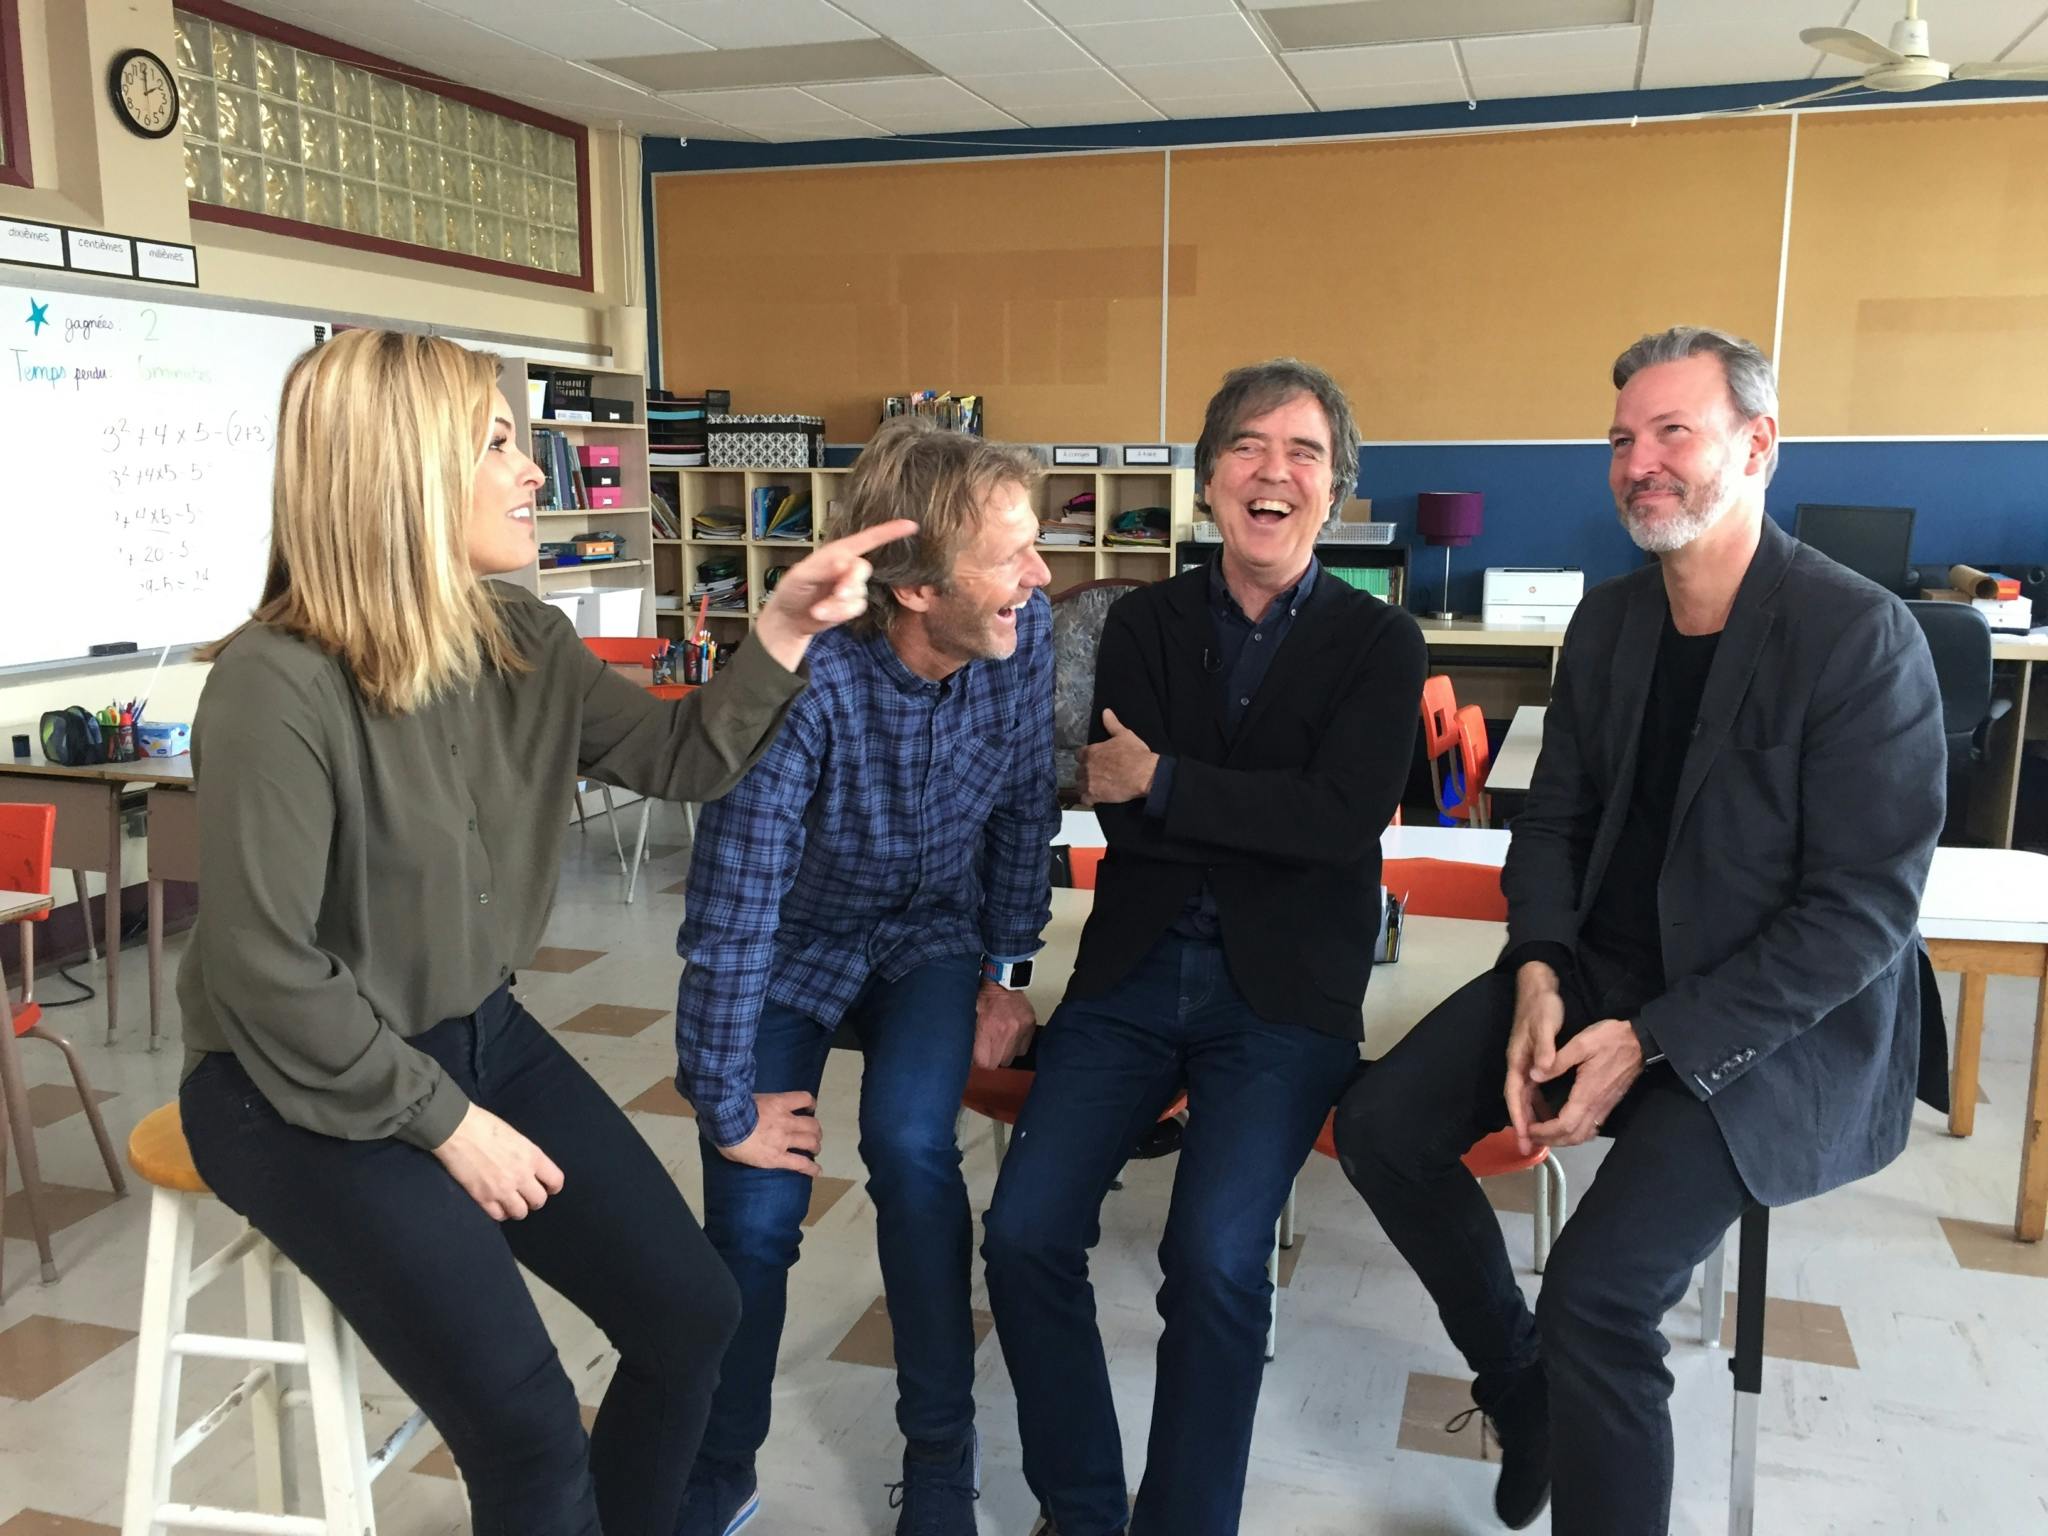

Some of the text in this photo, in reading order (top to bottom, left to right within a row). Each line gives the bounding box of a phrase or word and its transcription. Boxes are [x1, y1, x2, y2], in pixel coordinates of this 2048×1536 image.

[132, 64, 138, 76] 11
[150, 68, 154, 80] 1
[124, 72, 134, 85] 10
[157, 78, 164, 91] 2
[123, 84, 128, 96] 9
[127, 97, 134, 109] 8
[160, 93, 168, 104] 3
[135, 108, 141, 120] 7
[158, 105, 164, 116] 4
[144, 114, 150, 126] 6
[153, 112, 160, 124] 5
[78, 238, 124, 253] centièmes
[140, 308, 160, 341] 2
[9, 348, 66, 389] Temps
